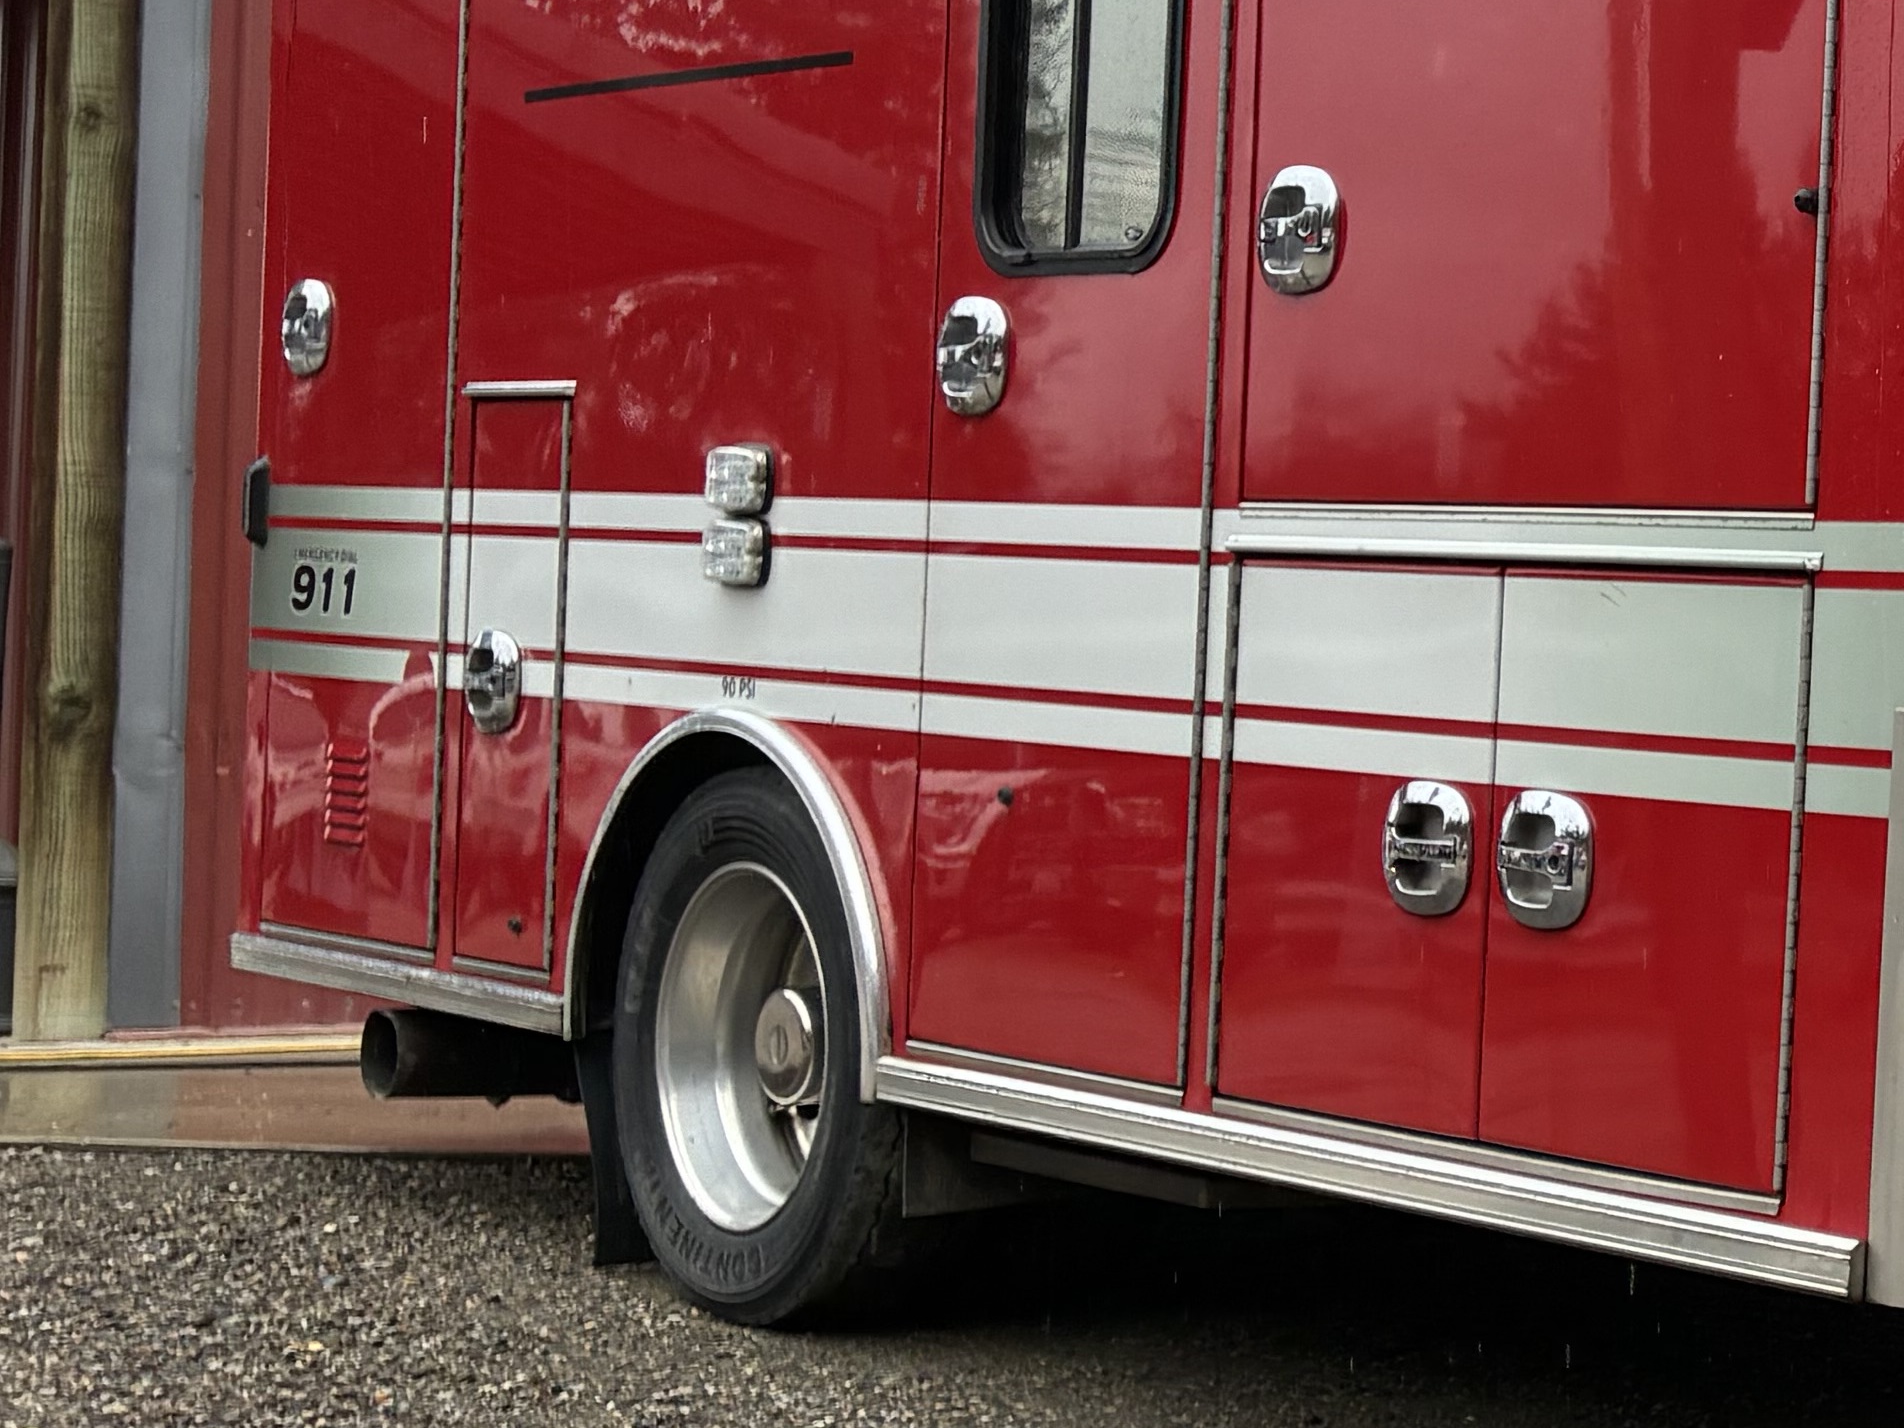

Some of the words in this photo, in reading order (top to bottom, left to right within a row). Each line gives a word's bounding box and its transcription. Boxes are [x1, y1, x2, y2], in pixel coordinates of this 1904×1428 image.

[291, 565, 357, 616] 911
[722, 676, 736, 698] 90
[739, 677, 756, 700] PSI
